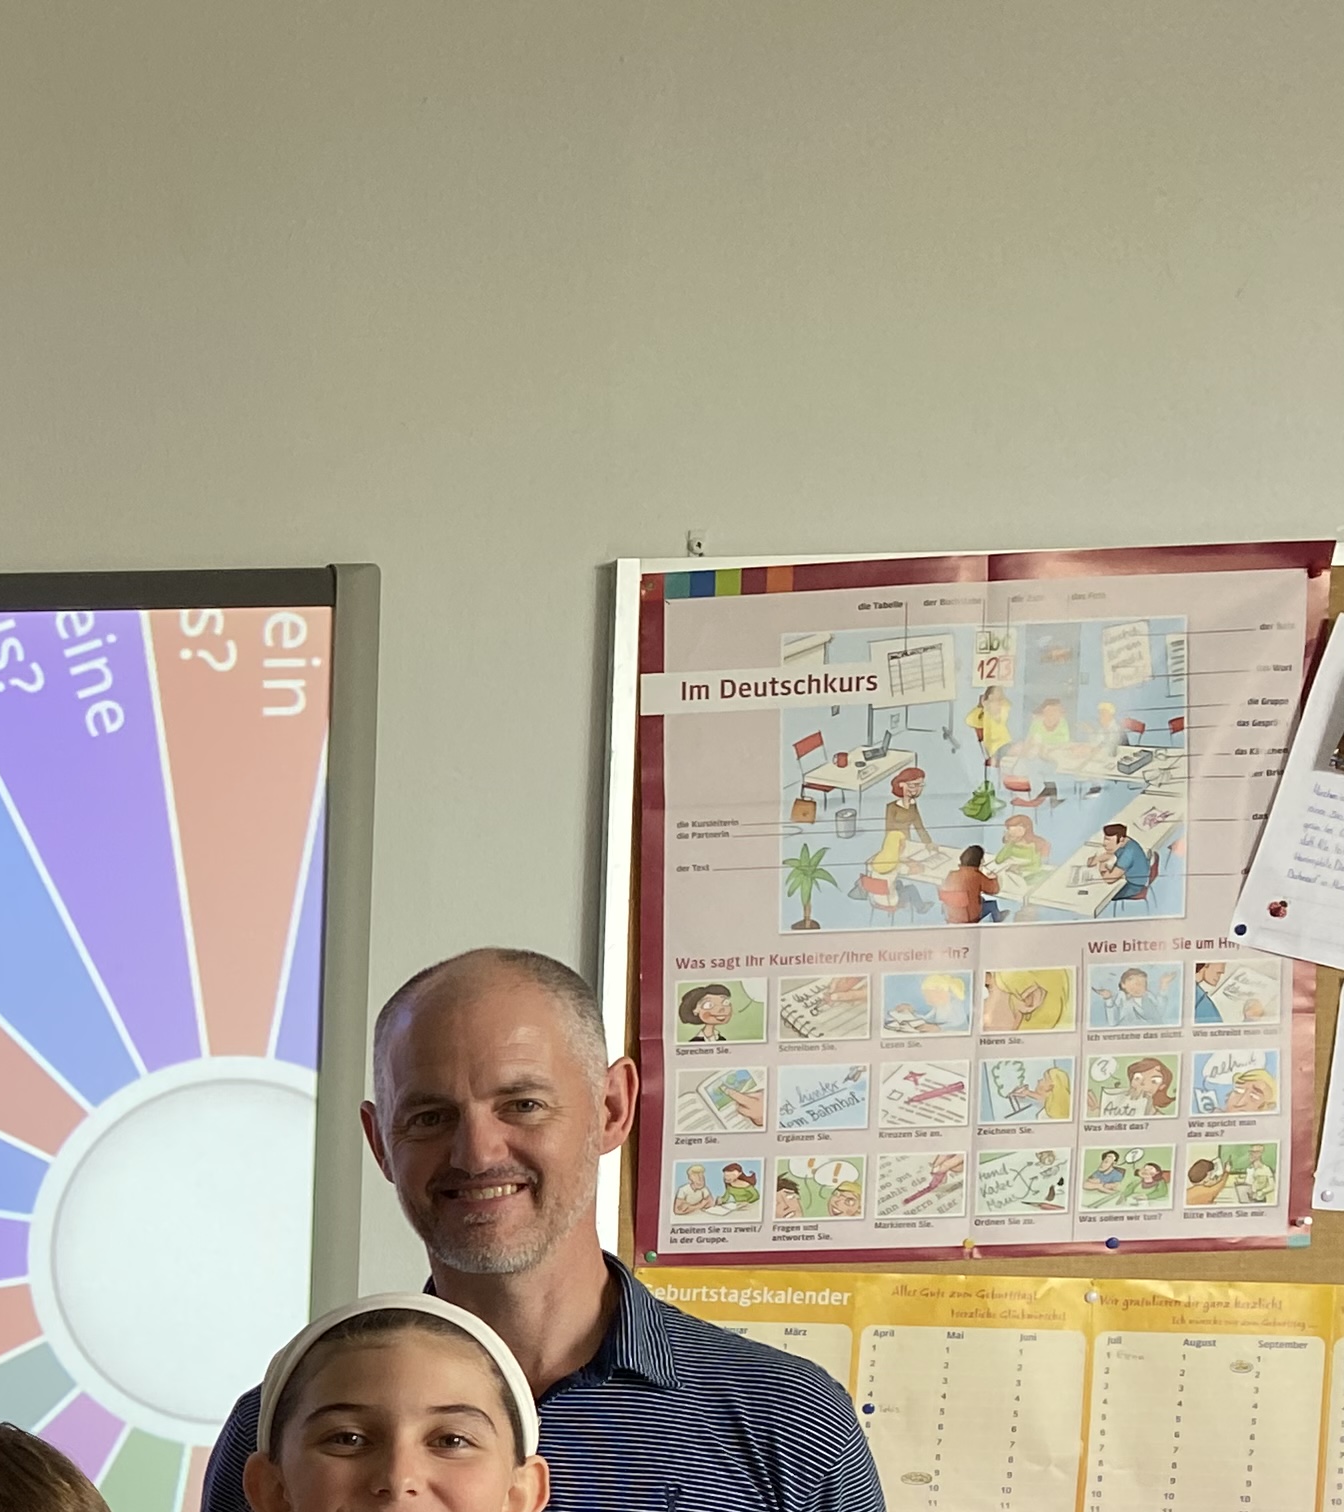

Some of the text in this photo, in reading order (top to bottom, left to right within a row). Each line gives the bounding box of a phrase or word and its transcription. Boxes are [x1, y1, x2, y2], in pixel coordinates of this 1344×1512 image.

[262, 611, 322, 716] ein
[681, 673, 878, 701] Im Deutschkurs
[1088, 940, 1117, 954] Wie
[1122, 939, 1163, 952] bitten
[1172, 937, 1192, 950] Sie
[1196, 939, 1214, 949] um
[675, 957, 706, 970] Was
[711, 957, 740, 970] sagt
[745, 955, 765, 967] Ihr
[872, 1328, 895, 1339] April
[946, 1330, 964, 1340] Mai
[1183, 1338, 1216, 1348] August
[1258, 1340, 1308, 1350] September
